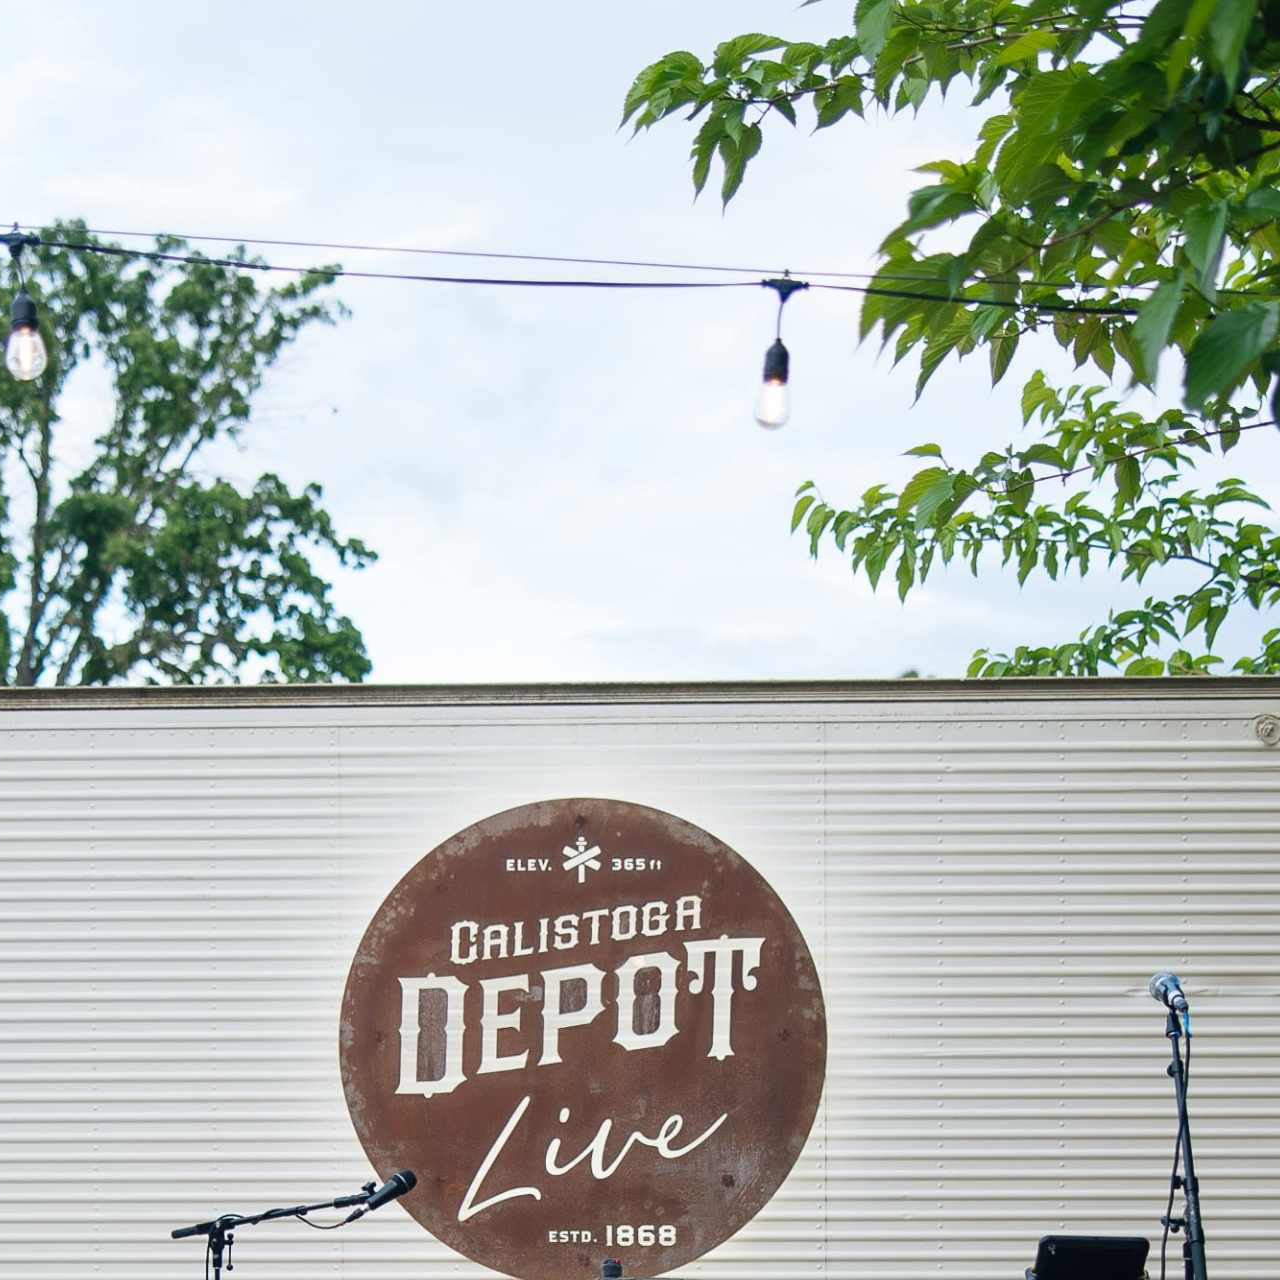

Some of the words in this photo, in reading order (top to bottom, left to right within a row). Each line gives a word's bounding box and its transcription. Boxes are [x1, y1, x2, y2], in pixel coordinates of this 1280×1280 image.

[505, 858, 552, 871] ELEV.
[449, 895, 703, 965] CALISTOGA
[394, 934, 766, 1098] DEPOT
[458, 1095, 728, 1222] Live
[548, 1229, 598, 1244] ESTD.
[604, 1224, 677, 1247] 1868
